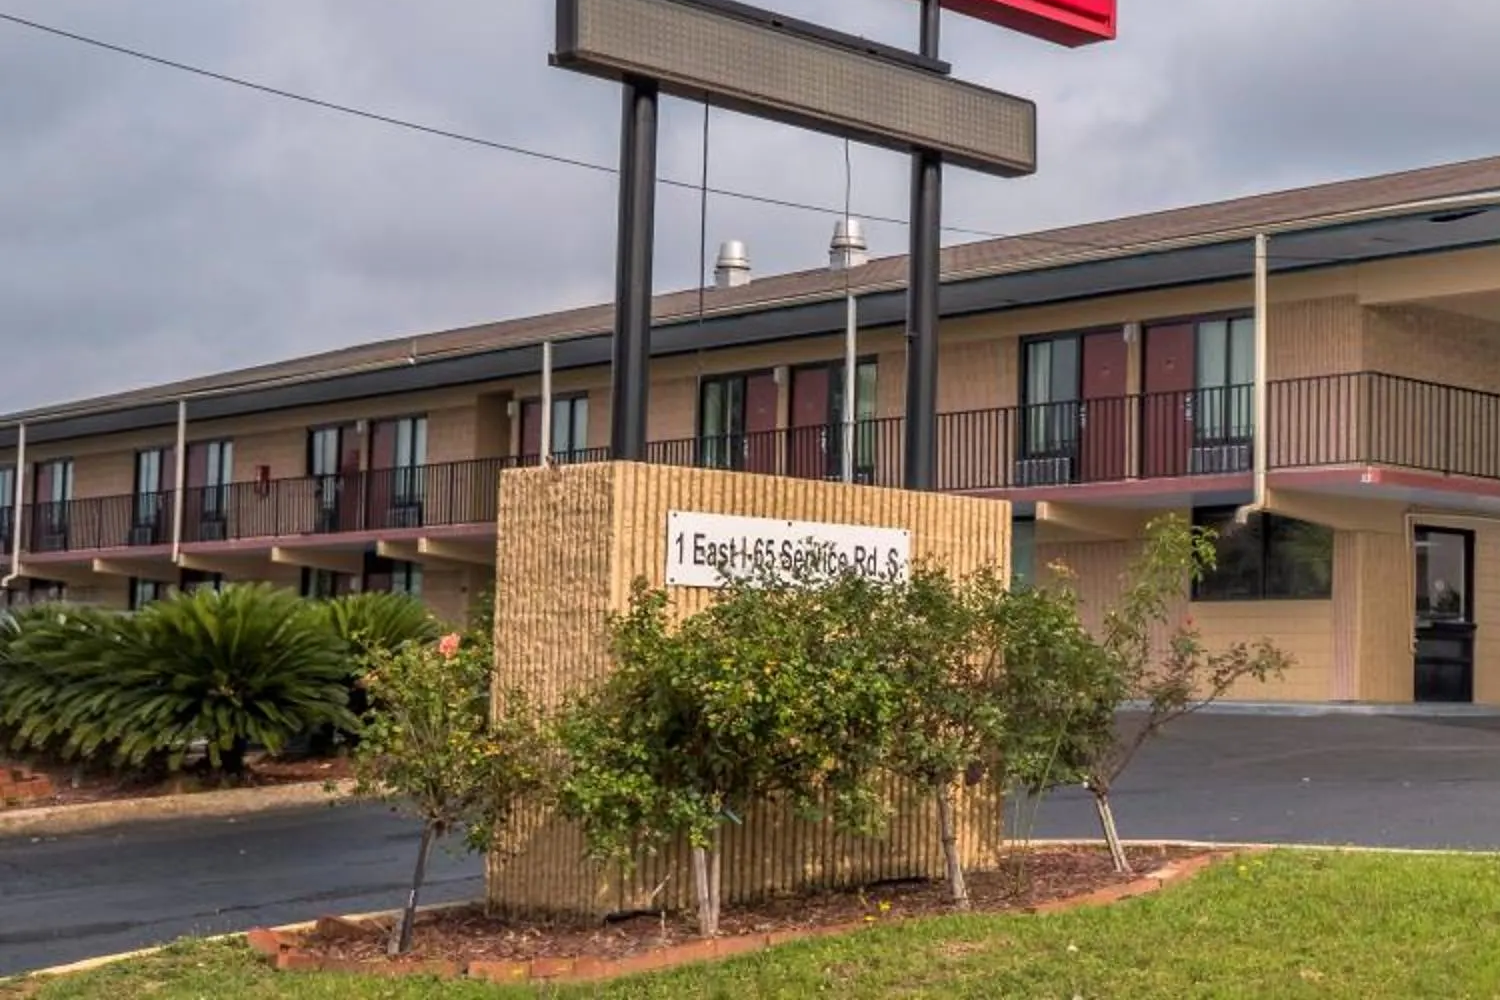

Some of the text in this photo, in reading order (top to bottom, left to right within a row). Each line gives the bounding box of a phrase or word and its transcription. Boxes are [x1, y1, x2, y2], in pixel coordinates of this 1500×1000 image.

[676, 531, 684, 565] 1
[694, 533, 736, 568] East
[742, 536, 776, 571] I-65
[781, 540, 849, 576] Service
